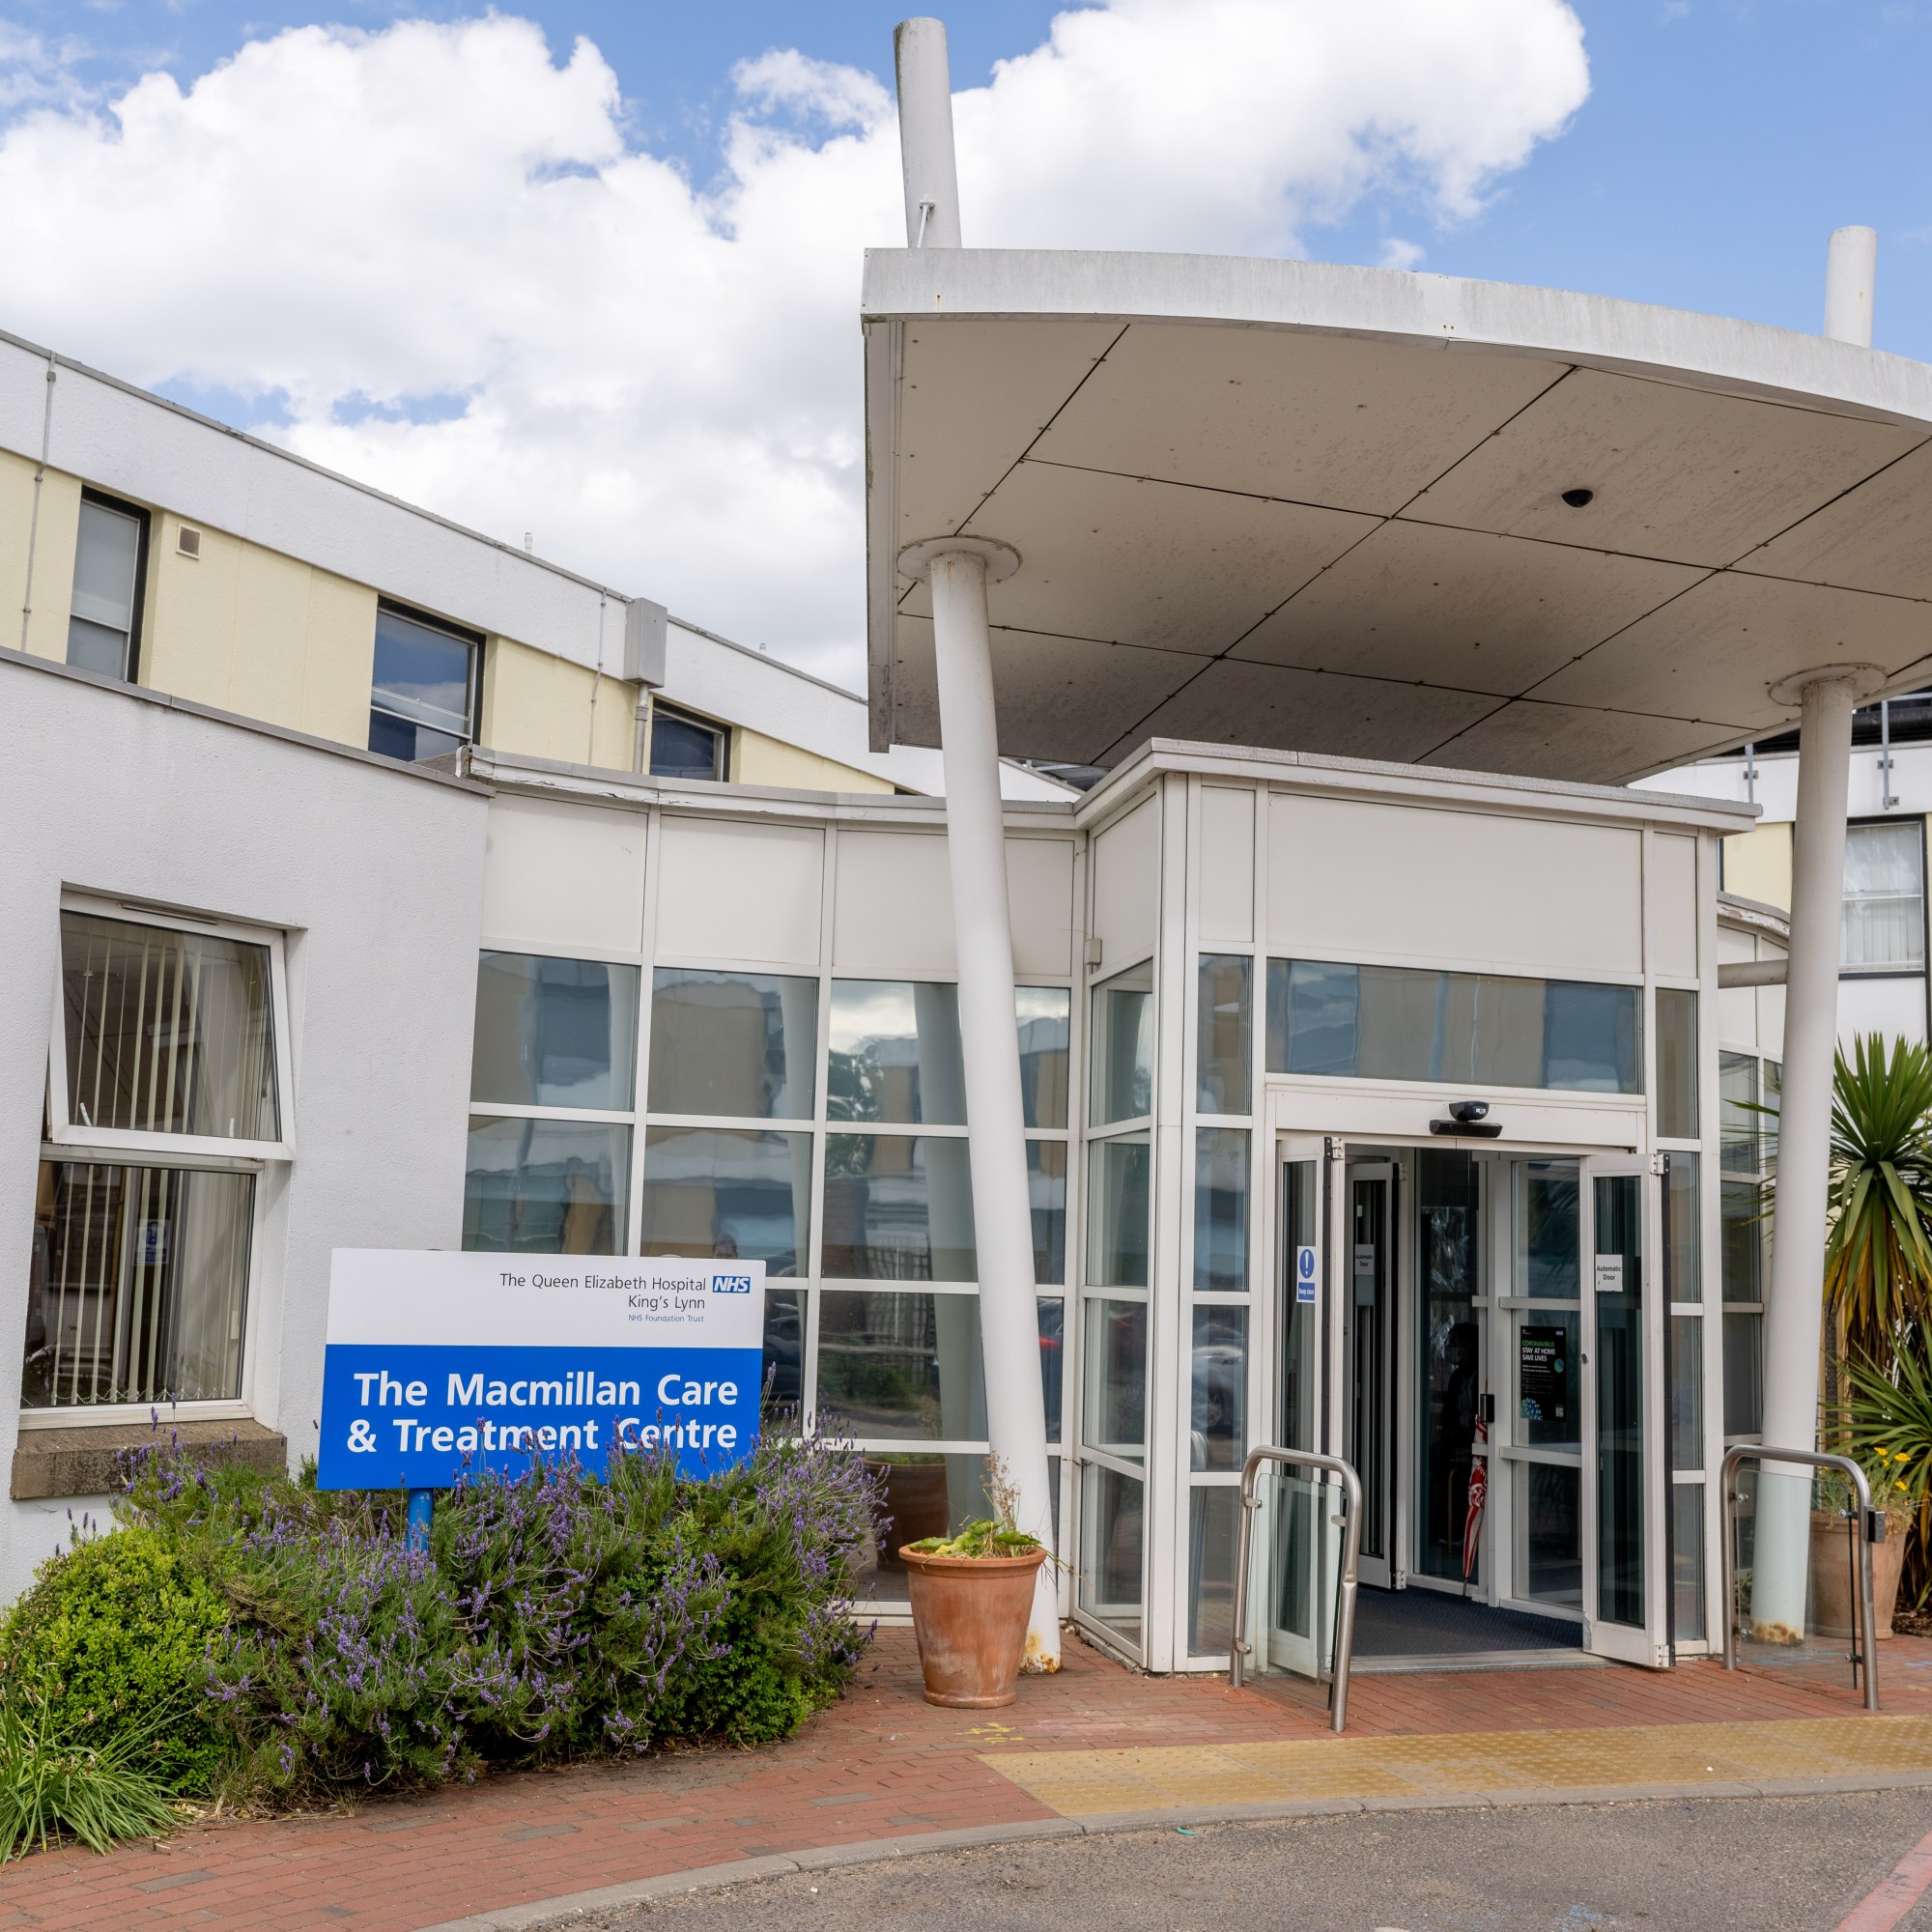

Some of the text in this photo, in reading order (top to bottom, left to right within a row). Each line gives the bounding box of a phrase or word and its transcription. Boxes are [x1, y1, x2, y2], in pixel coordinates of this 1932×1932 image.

[499, 1272, 751, 1293] The Queen Elizabeth Hospital NHS
[627, 1294, 706, 1313] King's Lynn
[628, 1314, 704, 1323] NHS Foundation Trust
[354, 1370, 738, 1406] The Macmillan Care
[346, 1417, 738, 1454] & Treatment Centre
